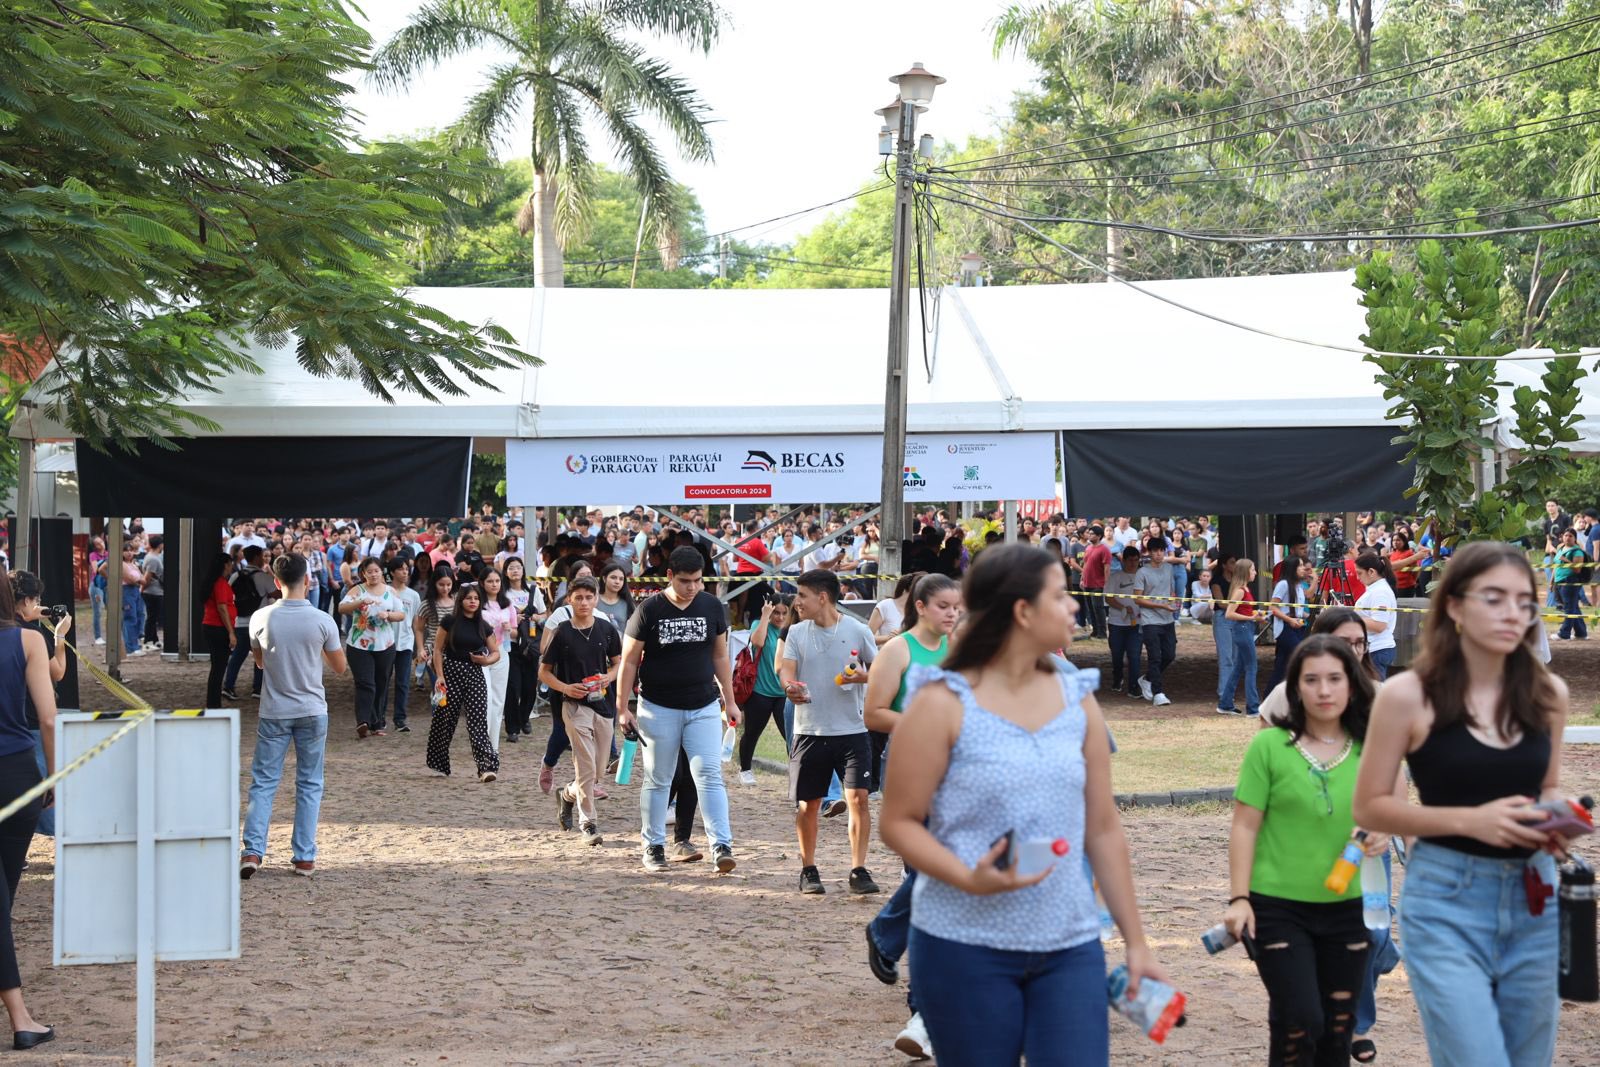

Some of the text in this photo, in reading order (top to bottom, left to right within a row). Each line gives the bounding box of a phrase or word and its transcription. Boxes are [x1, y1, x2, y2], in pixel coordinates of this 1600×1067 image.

[590, 454, 645, 463] GOBIERNO
[781, 452, 845, 468] BECAS
[591, 463, 658, 473] PARAGUAY
[689, 487, 767, 496] CONVOCATORIA 2024
